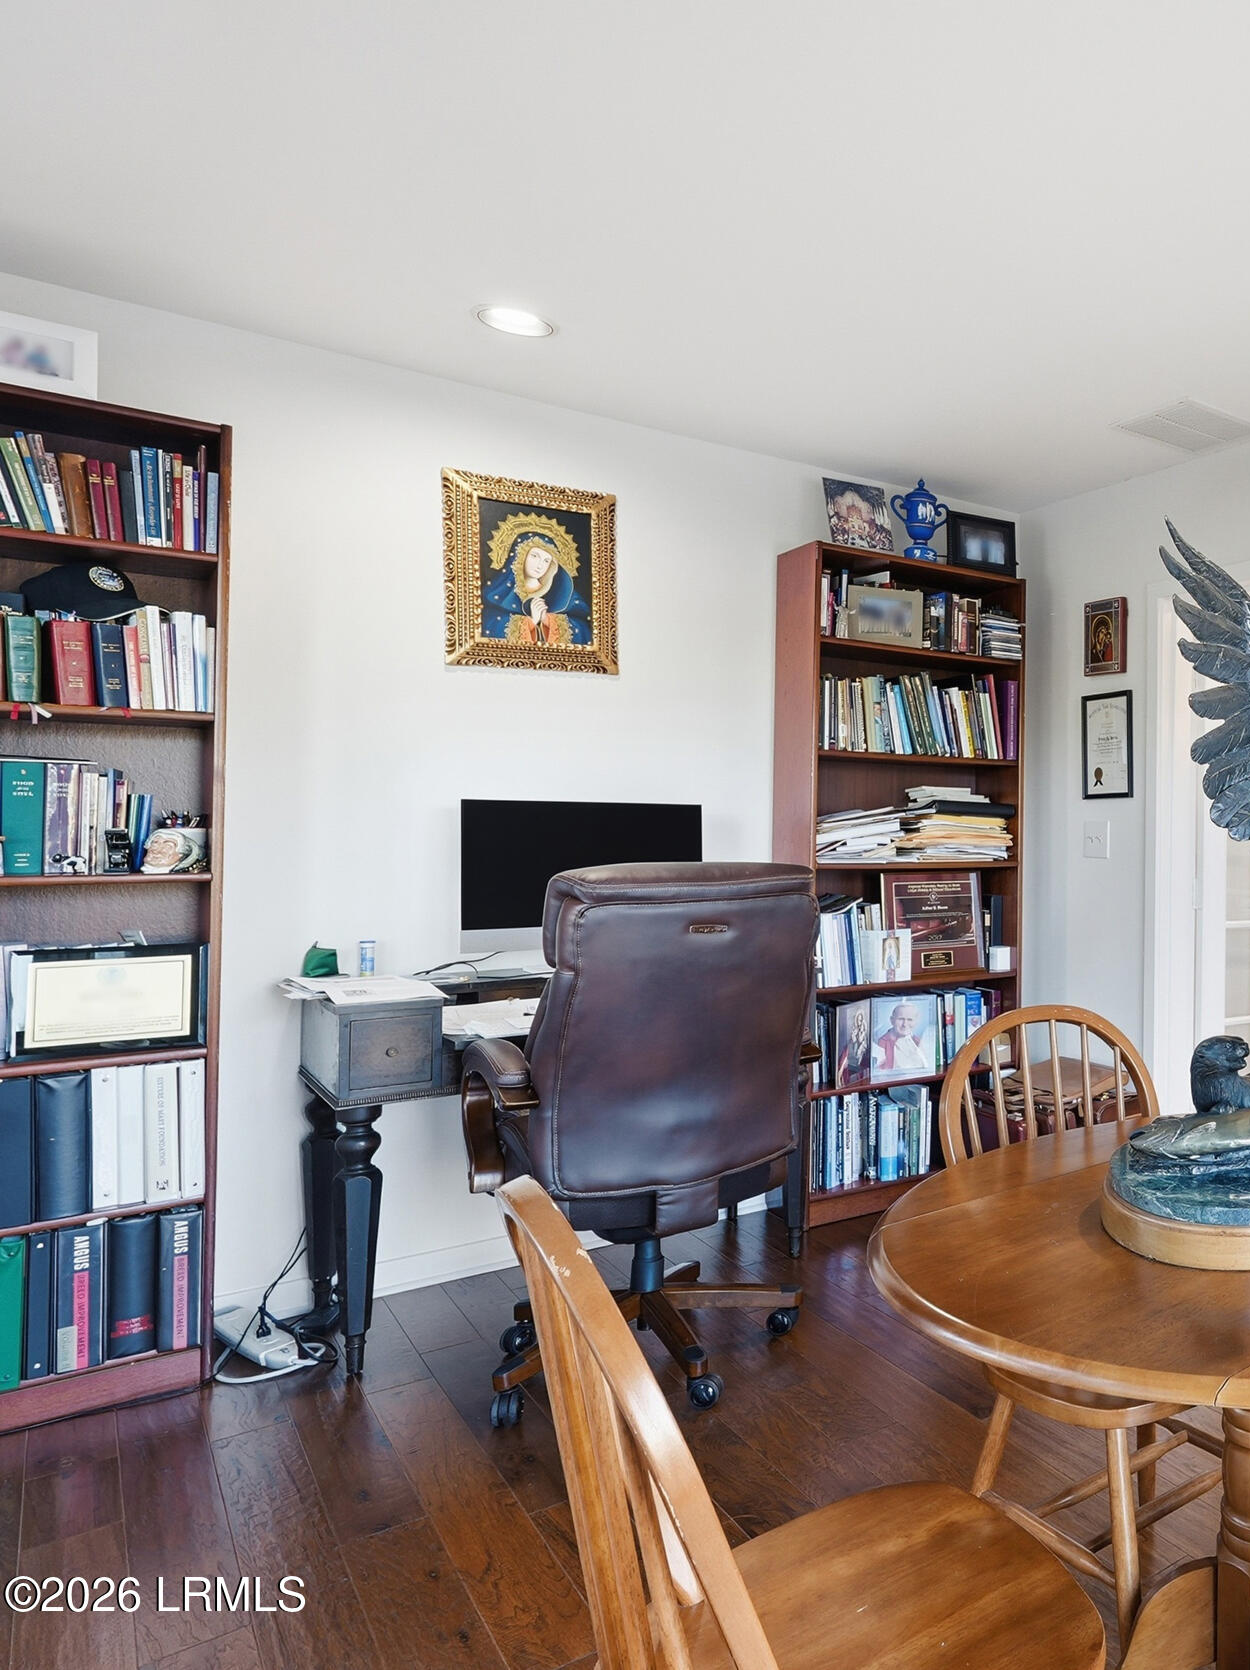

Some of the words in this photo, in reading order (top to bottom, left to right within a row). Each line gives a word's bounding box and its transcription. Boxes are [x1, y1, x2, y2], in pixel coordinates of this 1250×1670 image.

[73, 1235, 90, 1271] ANGUS
[174, 1220, 188, 1254] ANGUS
[175, 1257, 185, 1282] BREED
[76, 1275, 86, 1300] BREED
[176, 1284, 185, 1340] IMPROVEMENT
[76, 1302, 87, 1359] IMPROVEMENT
